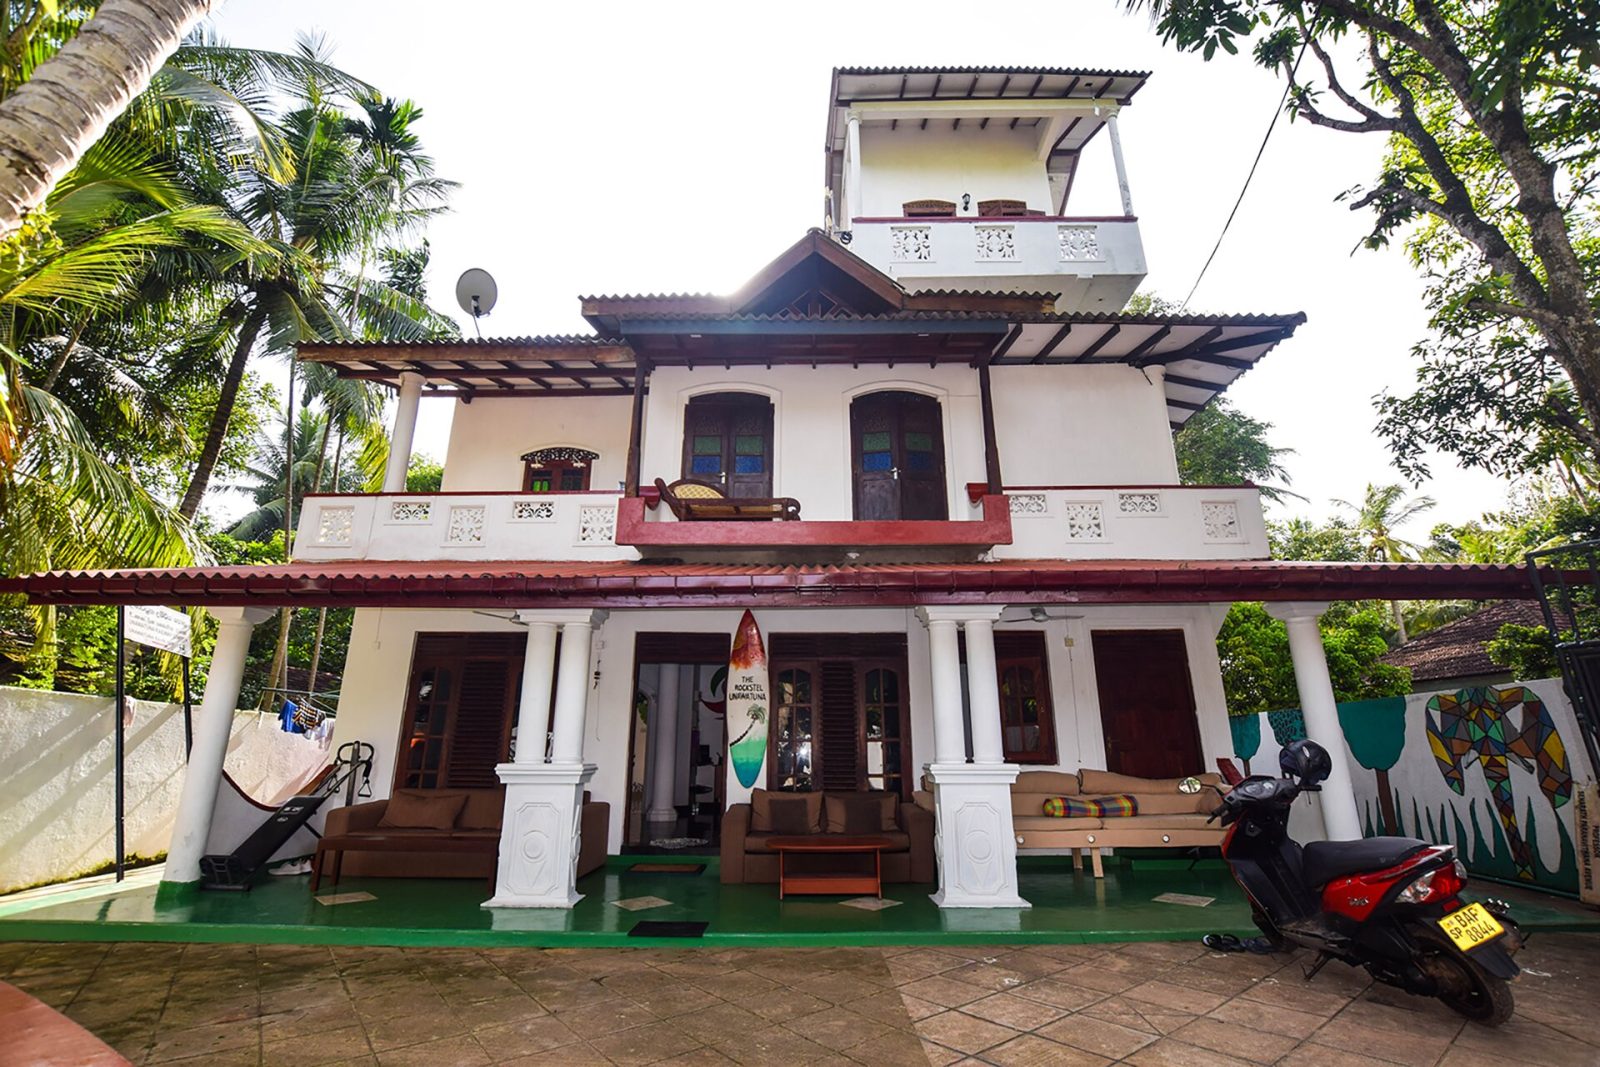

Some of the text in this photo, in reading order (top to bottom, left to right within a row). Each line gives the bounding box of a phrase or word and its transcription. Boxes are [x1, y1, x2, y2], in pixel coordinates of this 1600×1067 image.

[741, 675, 754, 684] THE
[734, 683, 764, 692] ROCKSTEL
[1454, 907, 1479, 928] BAF
[1450, 920, 1496, 943] SP 8844
